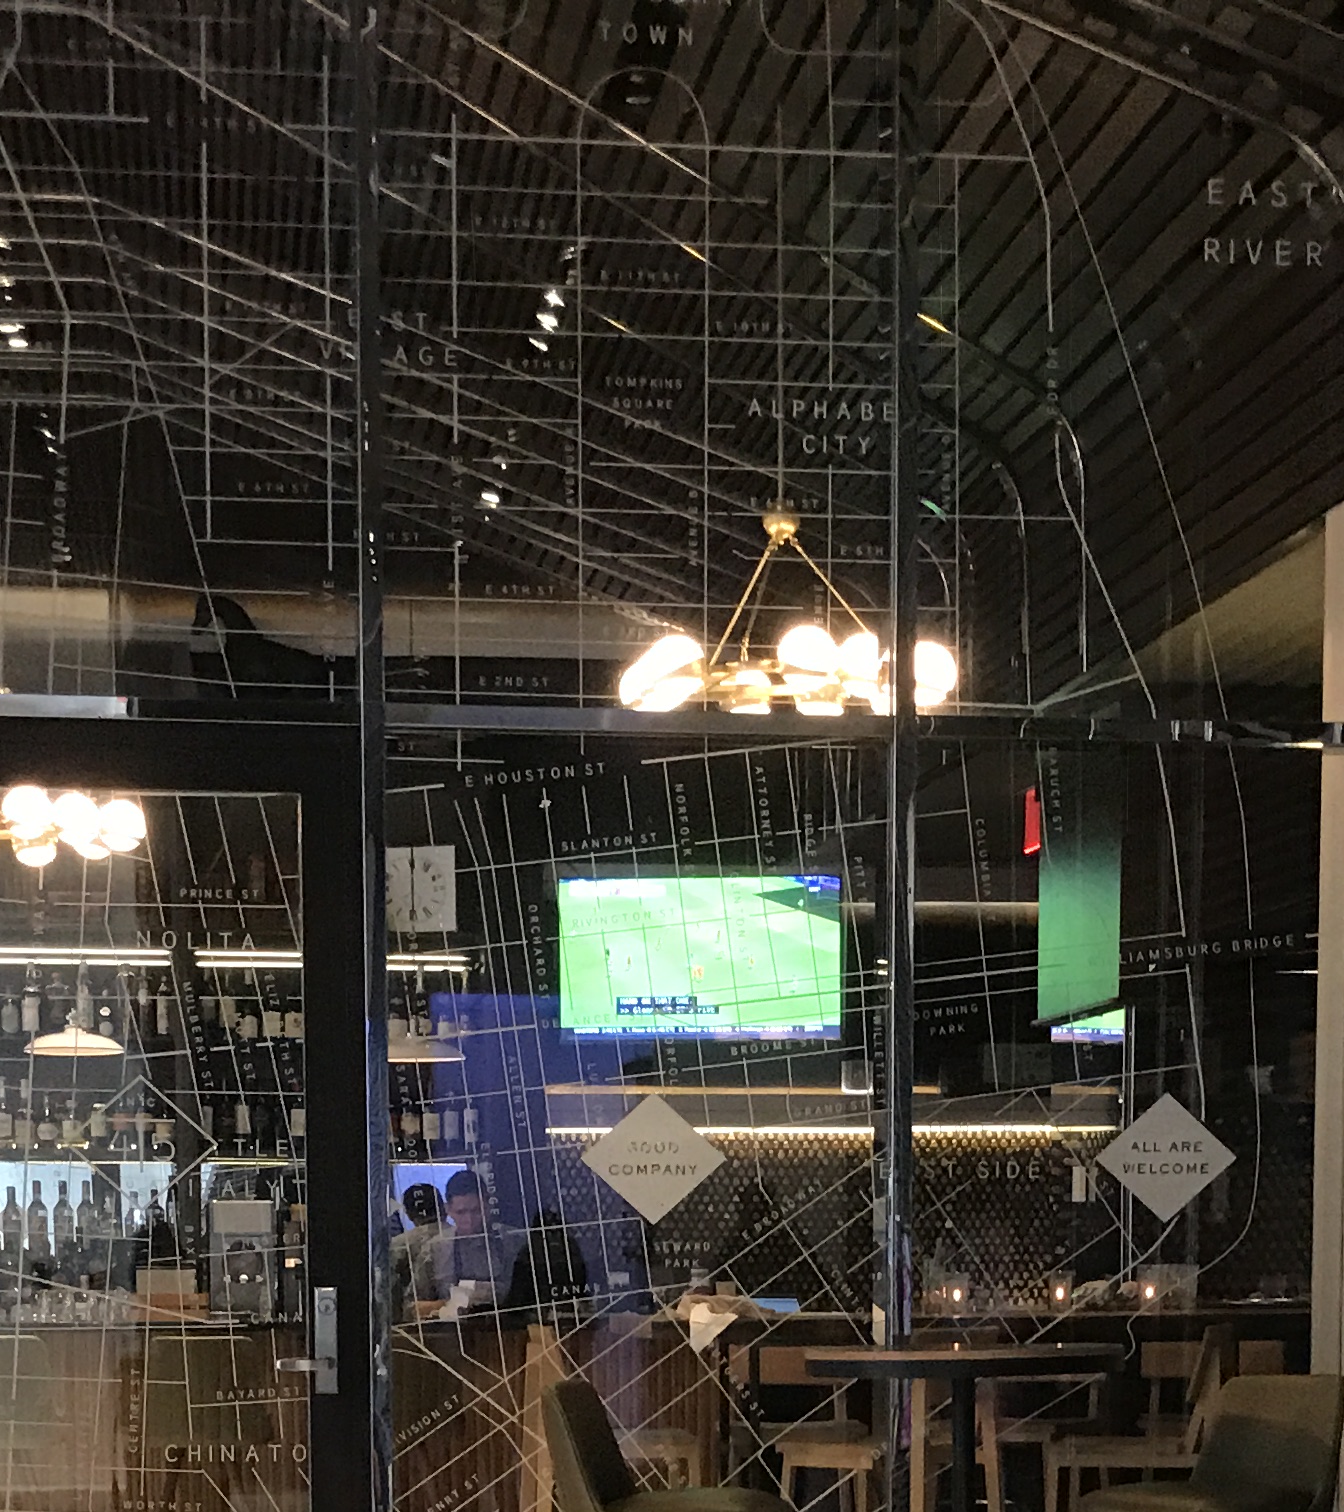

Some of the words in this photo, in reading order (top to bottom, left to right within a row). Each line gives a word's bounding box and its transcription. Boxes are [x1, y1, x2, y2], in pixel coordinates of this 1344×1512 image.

[597, 18, 694, 46] TOWN
[1207, 178, 1319, 209] EAST
[1203, 237, 1323, 267] RIVER
[747, 398, 897, 423] ALPHABE
[801, 434, 872, 456] CITY
[464, 775, 474, 788] E
[484, 764, 576, 786] HOUSTON
[584, 761, 606, 776] ST
[754, 766, 775, 849] ATTORNEY
[674, 783, 692, 857] NORFOLK
[640, 832, 657, 844] ST
[974, 817, 992, 898] COLUMBIA
[179, 887, 233, 900] PRINCE
[241, 887, 261, 900] ST
[136, 929, 256, 950] NOLITA
[527, 903, 547, 977] ORCHARD
[1119, 942, 1223, 965] LIAMSBURG
[1231, 933, 1295, 952] BRIDGE
[182, 980, 209, 1063] MULBERRY
[200, 1070, 215, 1088] ST
[929, 1022, 966, 1037] PARK
[730, 1039, 793, 1056] BROOME
[242, 1062, 257, 1081] ST
[664, 1036, 680, 1086] ORFOL
[507, 1055, 525, 1106] ALLEN
[516, 1110, 527, 1128] ST
[1131, 1141, 1162, 1153] ALL
[1168, 1141, 1204, 1153] ARE
[608, 1163, 698, 1177] COMPANY
[975, 1160, 1041, 1180] SIDE
[1122, 1162, 1210, 1175] WELCOME
[251, 1312, 303, 1324] CANA
[130, 1367, 141, 1385] ST
[215, 1387, 276, 1401] BAYARD
[128, 1391, 140, 1454] CENTRE
[395, 1409, 442, 1445] IVISION
[443, 1394, 460, 1411] ST
[164, 1443, 308, 1462] CHINATO
[464, 1472, 480, 1489] ST
[123, 1499, 178, 1511] WORTH
